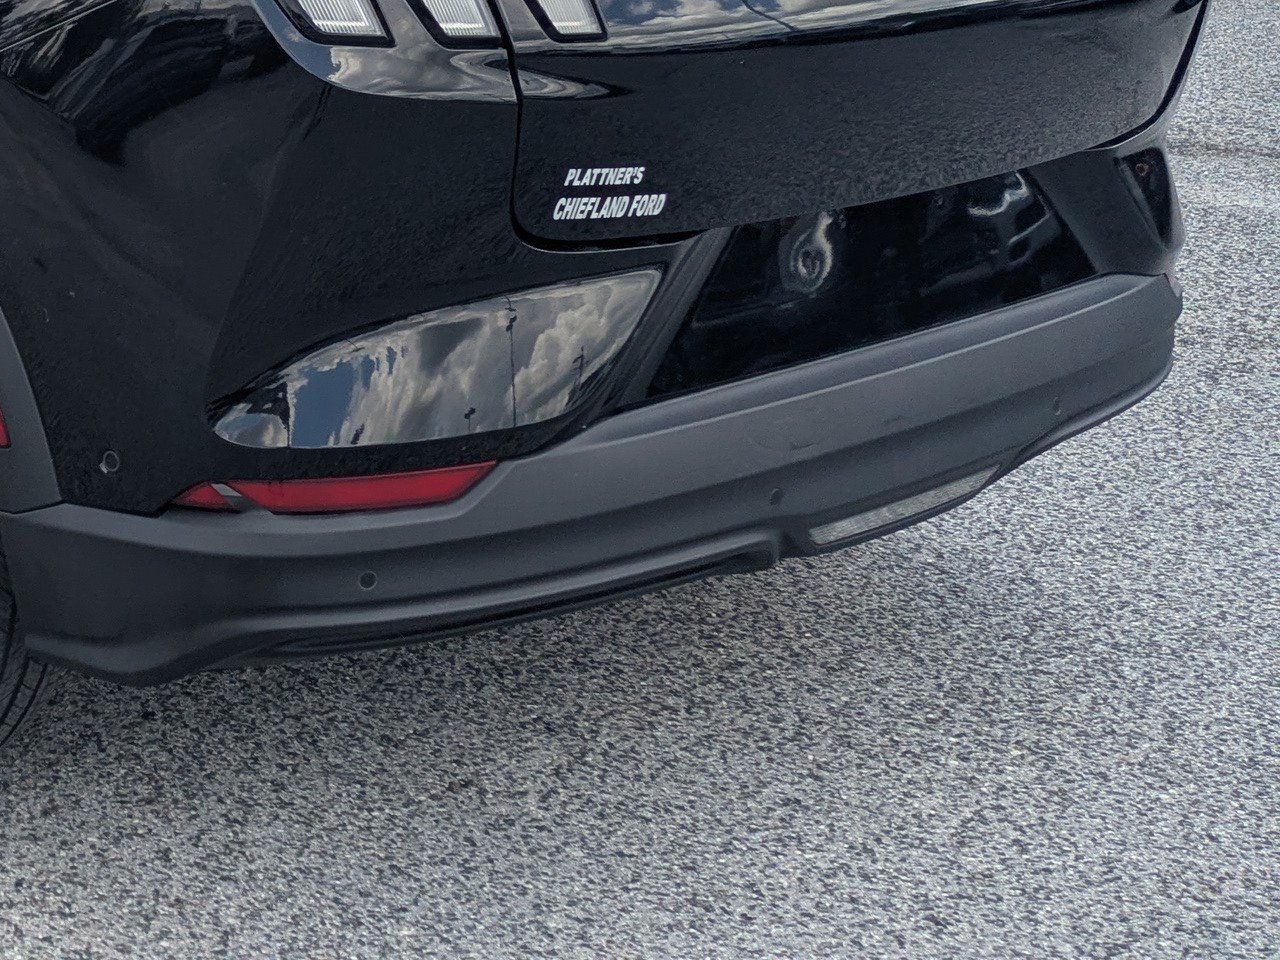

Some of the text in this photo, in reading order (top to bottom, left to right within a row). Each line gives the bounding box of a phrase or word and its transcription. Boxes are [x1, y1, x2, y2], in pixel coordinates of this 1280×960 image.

[563, 166, 646, 187] PLATTNER'S
[552, 193, 668, 221] CHIEFLAND FORD
